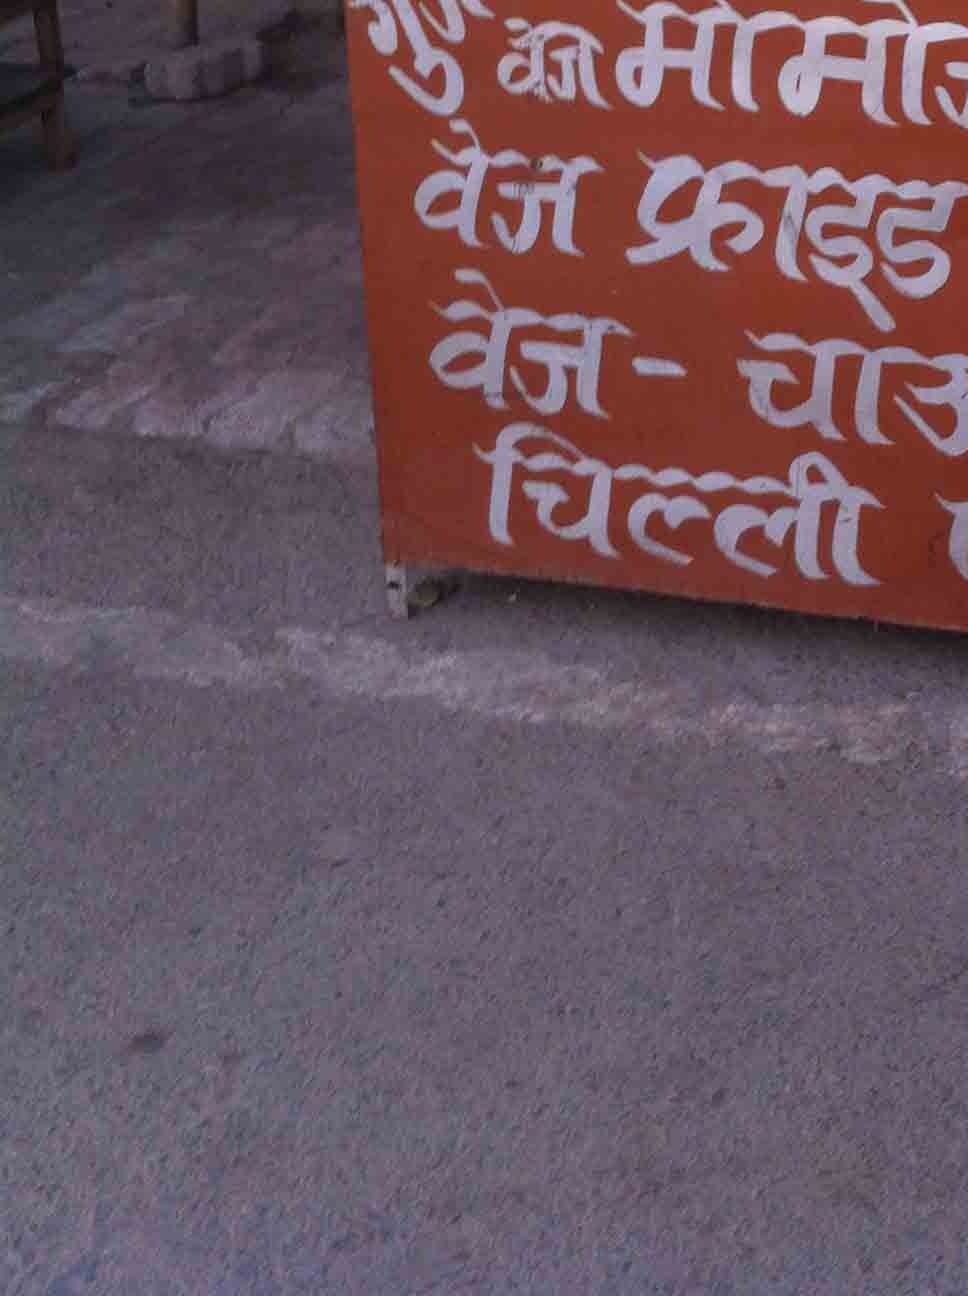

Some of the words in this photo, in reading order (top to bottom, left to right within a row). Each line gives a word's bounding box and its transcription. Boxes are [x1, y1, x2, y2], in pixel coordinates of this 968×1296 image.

[498, 17, 612, 110] वेज
[414, 119, 605, 257] वेज
[473, 420, 881, 587] चिल्ली
